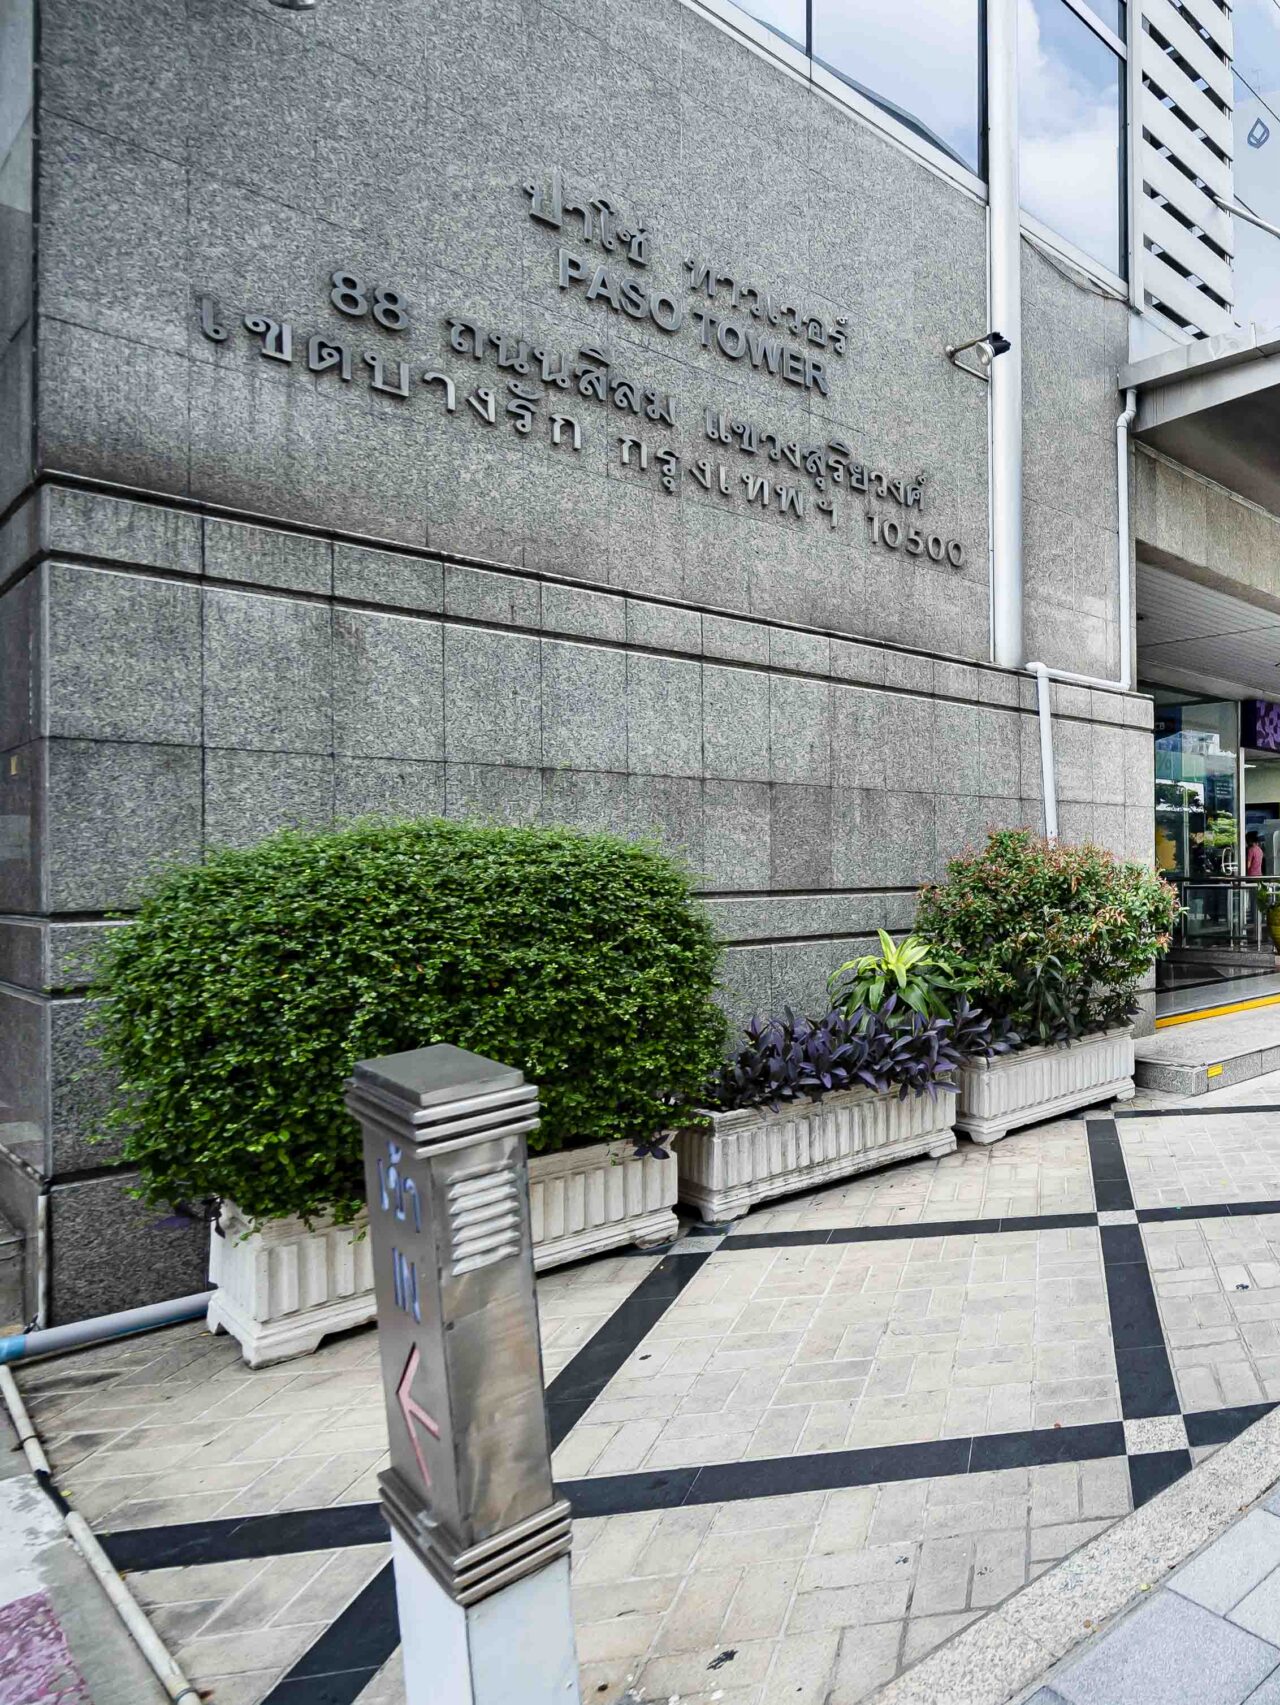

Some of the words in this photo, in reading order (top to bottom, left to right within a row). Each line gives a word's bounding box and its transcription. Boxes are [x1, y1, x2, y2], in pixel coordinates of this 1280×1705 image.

[523, 166, 648, 267] ปาโซ่
[684, 253, 849, 354] ทาวเวอร์
[559, 249, 682, 331] PASO
[693, 310, 830, 397] TOWER
[199, 297, 582, 451] เขตบางรัก
[866, 513, 966, 569] 10500
[330, 270, 410, 330] 88
[446, 317, 676, 426] ถนนสีลม
[705, 405, 927, 511] แขวงสุริยวงศ์
[377, 1140, 422, 1234] เข้า
[393, 1246, 421, 1325] IN
